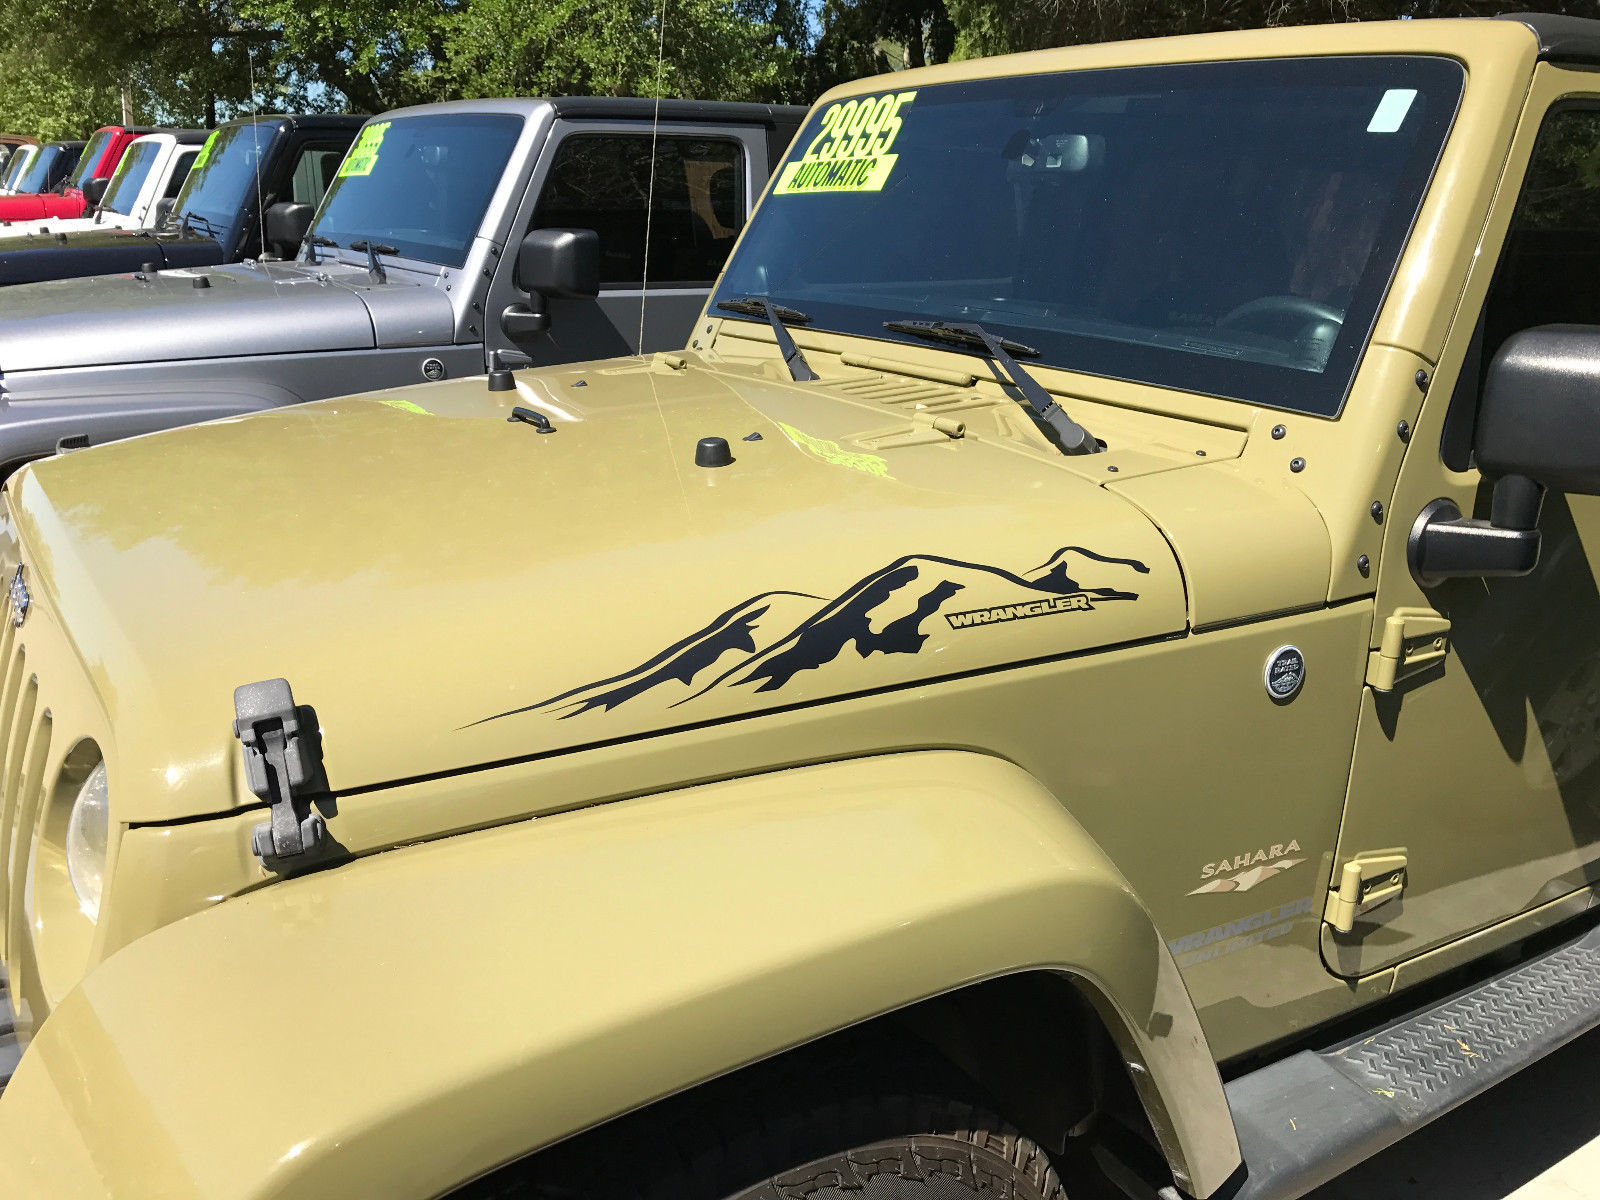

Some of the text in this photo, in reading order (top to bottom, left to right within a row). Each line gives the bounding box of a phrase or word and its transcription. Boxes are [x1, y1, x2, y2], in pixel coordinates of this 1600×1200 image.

[801, 91, 918, 161] 29995
[786, 157, 878, 190] AUTOMATIC
[945, 594, 1093, 630] WRANGLER
[1200, 839, 1301, 879] SAHARA
[1180, 921, 1295, 968] UNLIMITED
